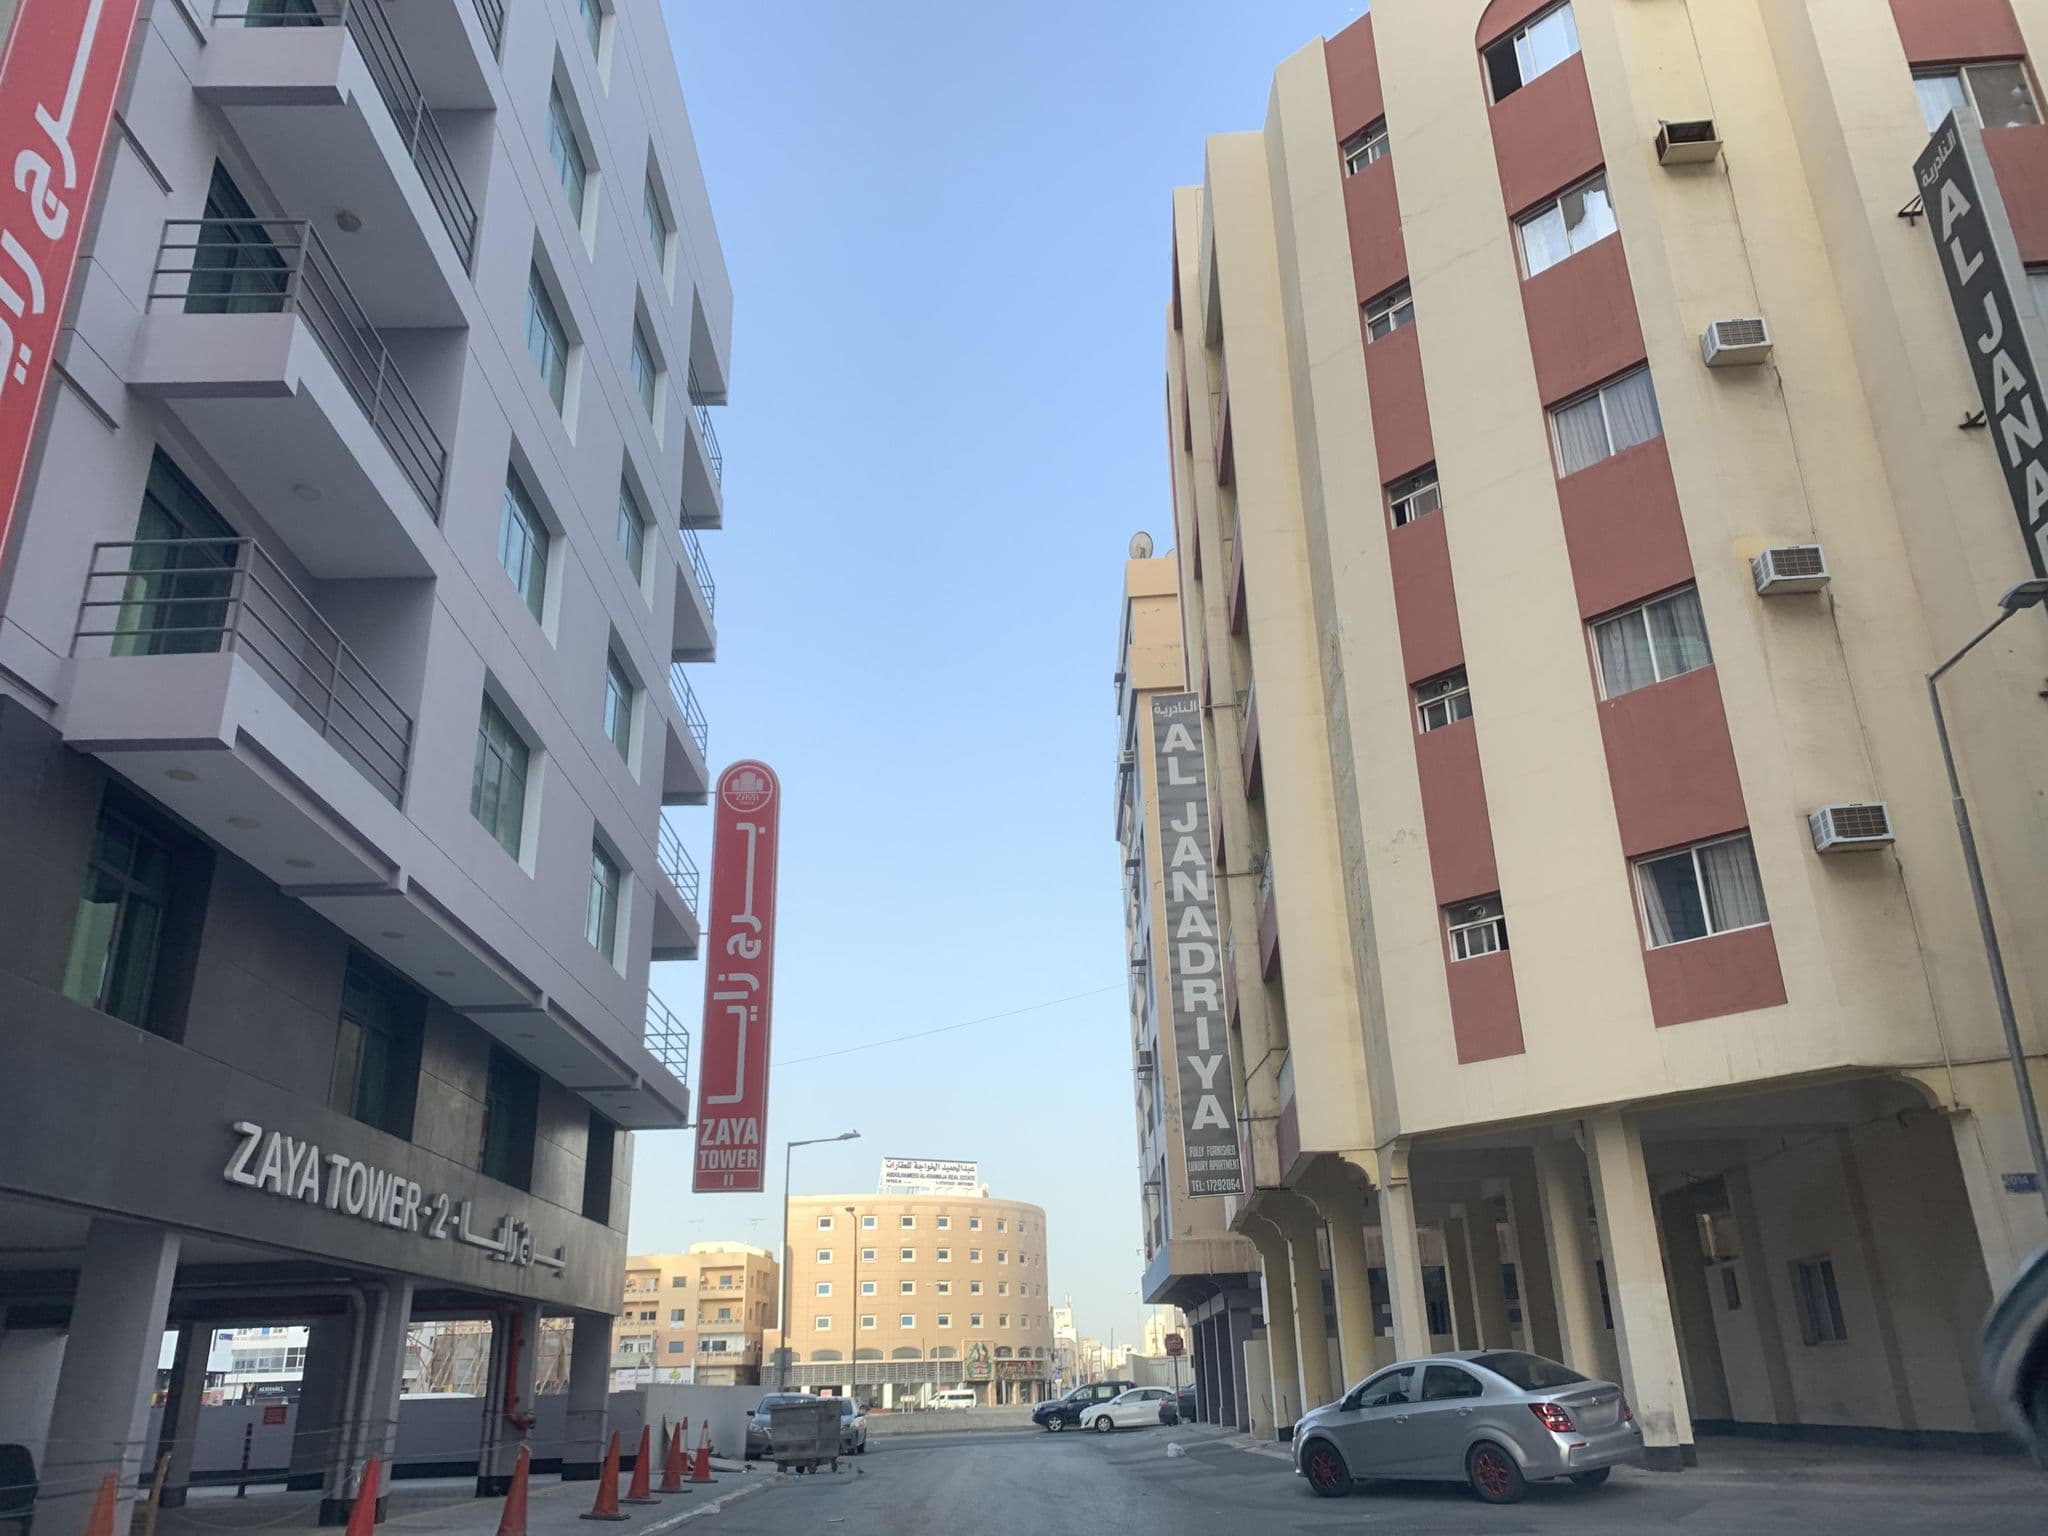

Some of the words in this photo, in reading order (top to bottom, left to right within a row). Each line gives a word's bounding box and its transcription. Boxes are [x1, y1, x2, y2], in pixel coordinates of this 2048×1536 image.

[1939, 177, 1984, 287] AL
[1977, 291, 2048, 578] JANA
[1162, 723, 1197, 786] AL
[1171, 802, 1230, 1130] JANADRIYA
[224, 1121, 319, 1204] ZAYA
[699, 1149, 758, 1169] TOWER
[700, 1116, 759, 1146] ZAYA
